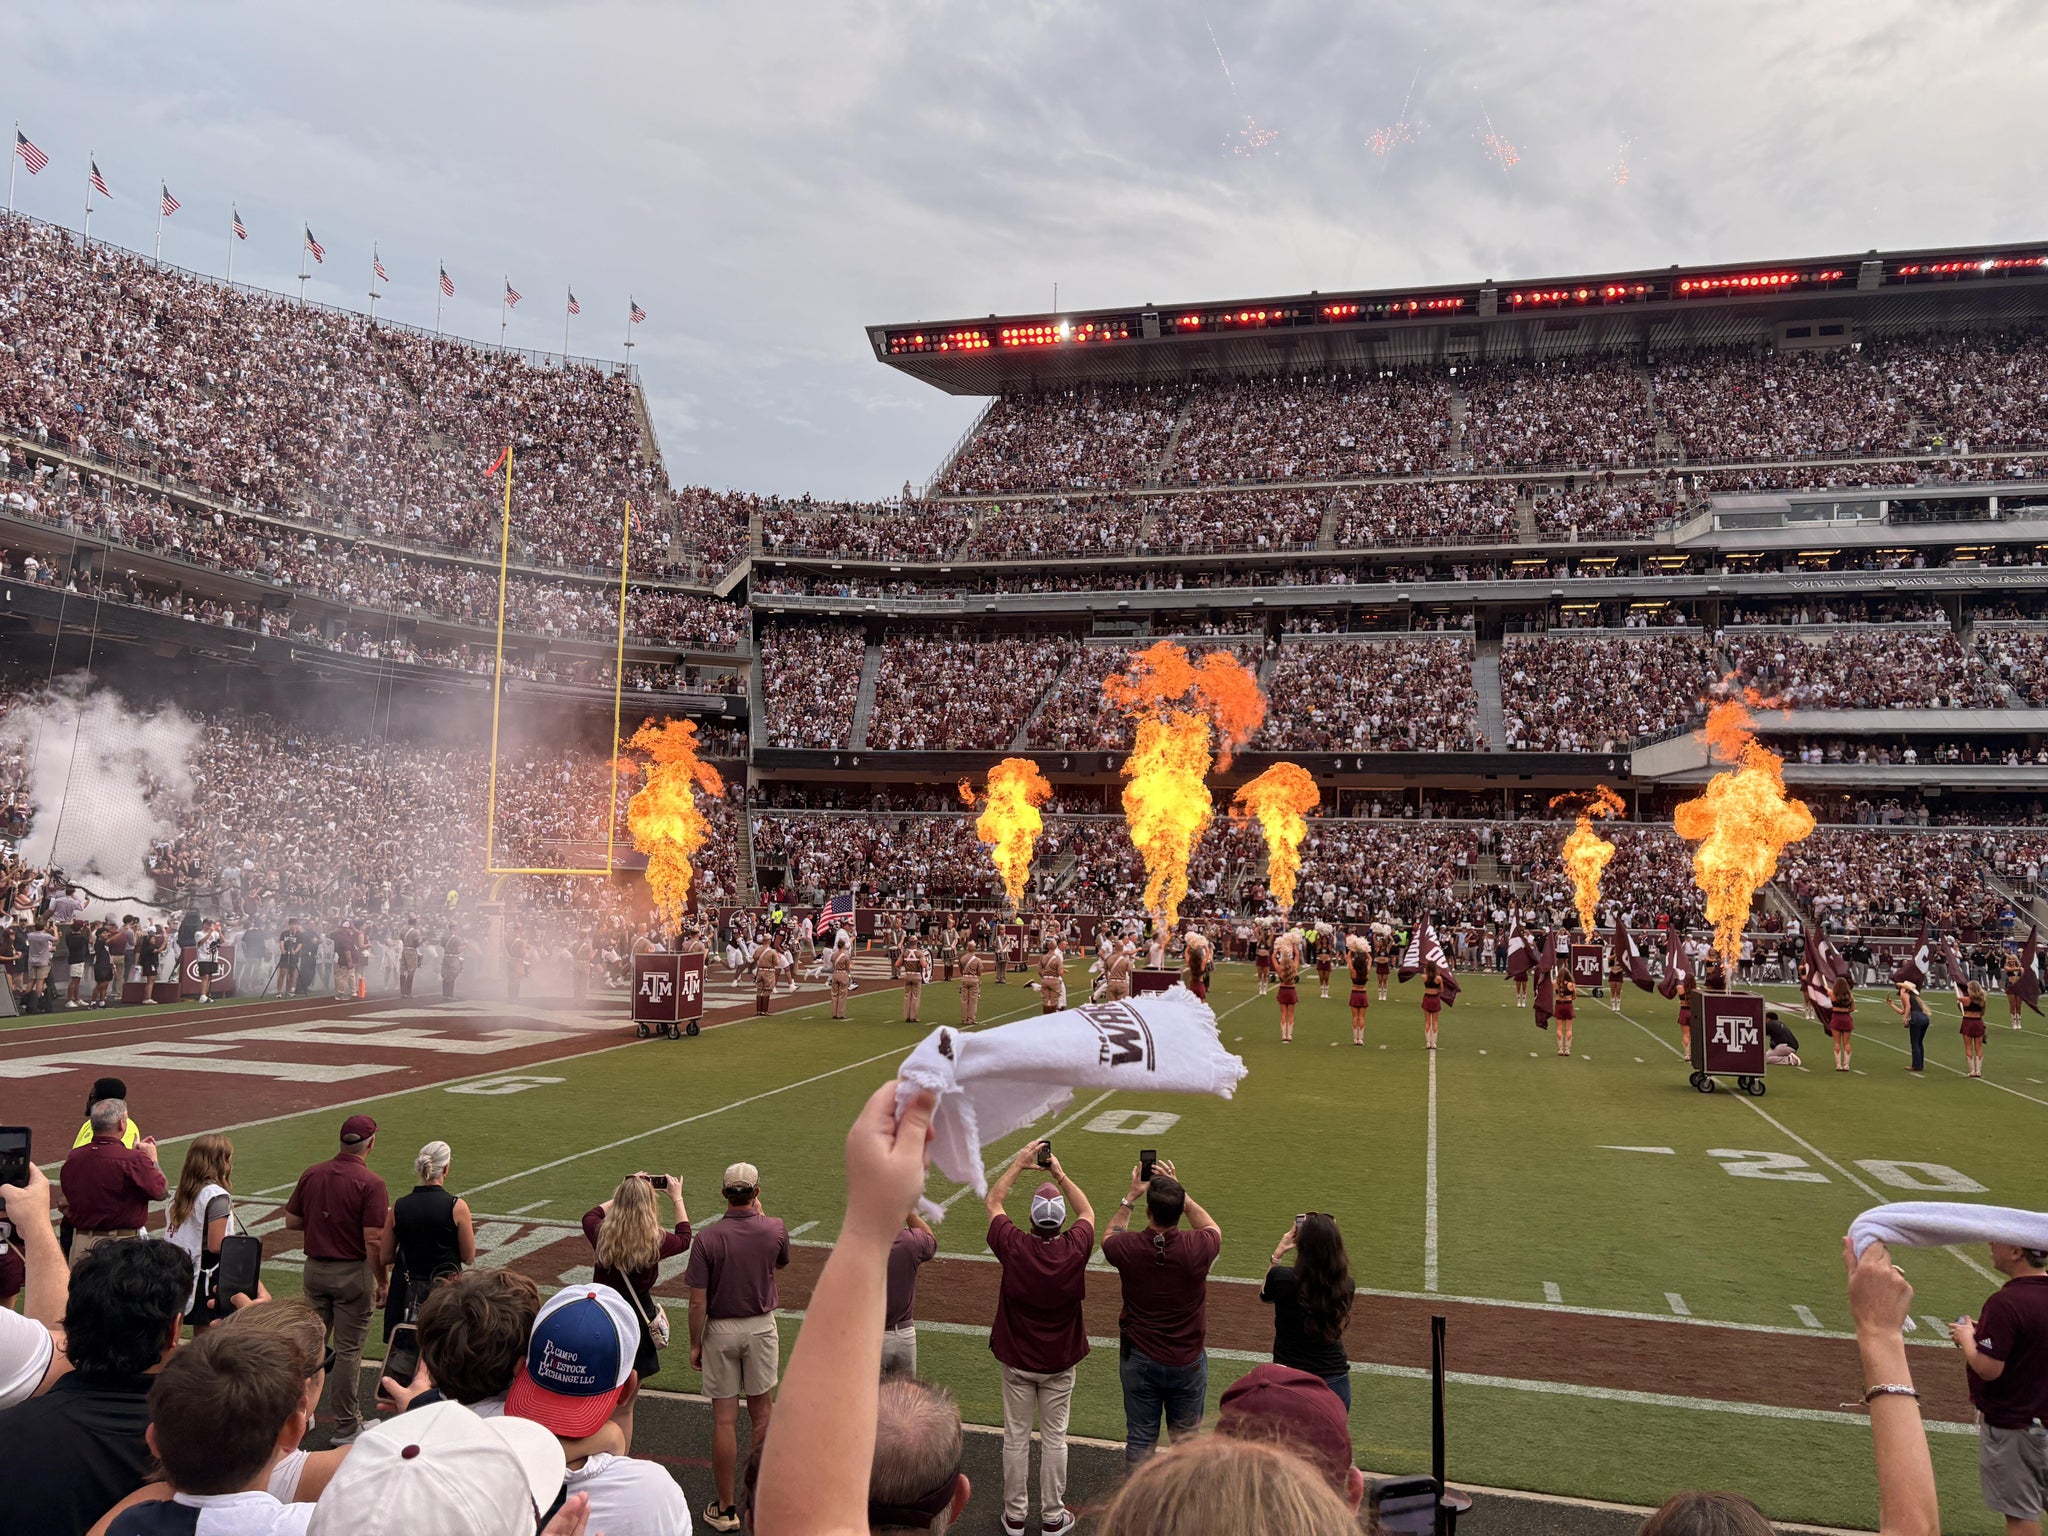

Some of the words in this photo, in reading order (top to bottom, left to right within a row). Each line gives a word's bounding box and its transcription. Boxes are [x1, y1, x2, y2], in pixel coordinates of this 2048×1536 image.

[1788, 577, 1942, 589] WELCOME
[1945, 576, 1990, 585] TO
[639, 971, 672, 1003] ATM
[1711, 1015, 1759, 1053] ATM
[1099, 1036, 1110, 1065] The
[554, 1347, 578, 1361] CAMPO
[538, 1361, 579, 1384] EXCHANGE
[579, 1375, 595, 1385] LLC
